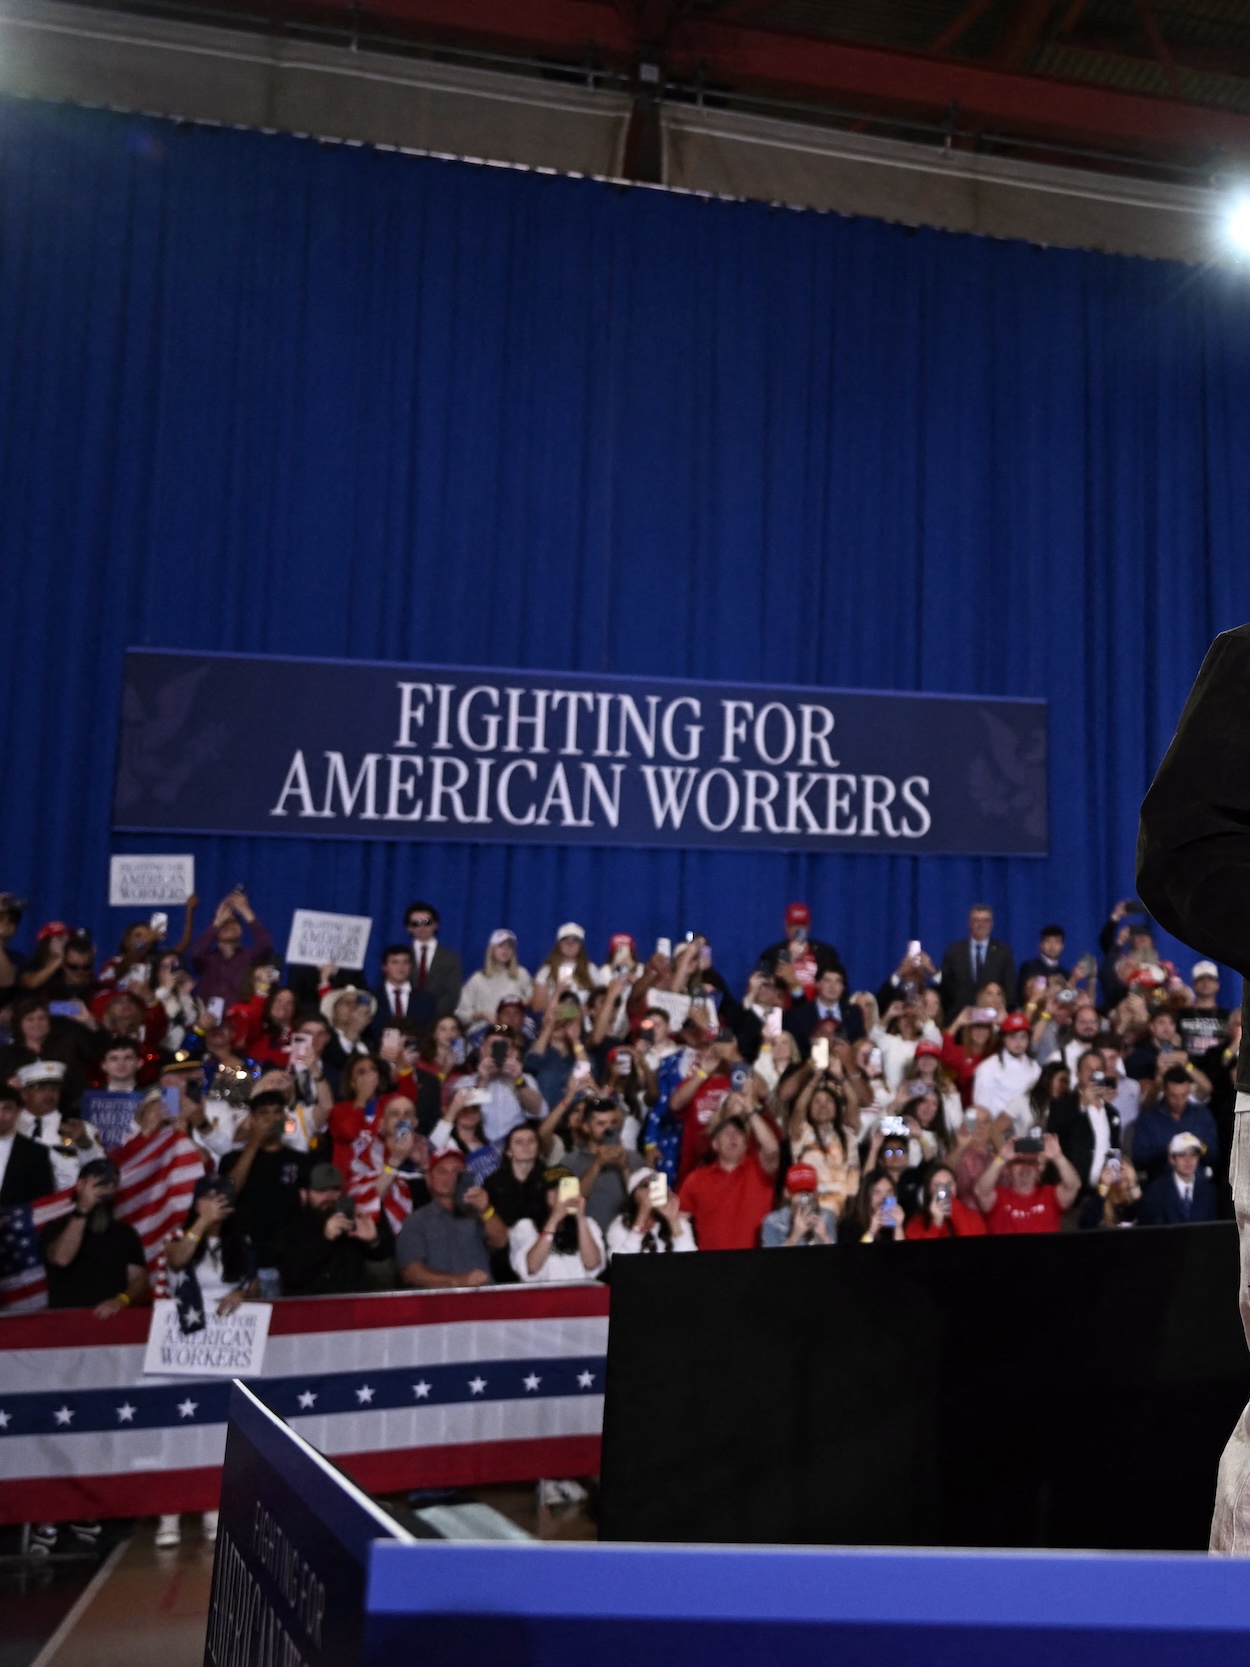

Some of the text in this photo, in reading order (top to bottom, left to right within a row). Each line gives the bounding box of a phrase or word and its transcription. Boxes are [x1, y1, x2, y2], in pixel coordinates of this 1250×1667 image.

[396, 682, 840, 768] FIGHTING FOR
[271, 750, 931, 838] AMERICAN WORKERS
[160, 1347, 252, 1369] WORKERS
[253, 1500, 300, 1609] FIGHTING
[298, 1560, 327, 1652] FOR
